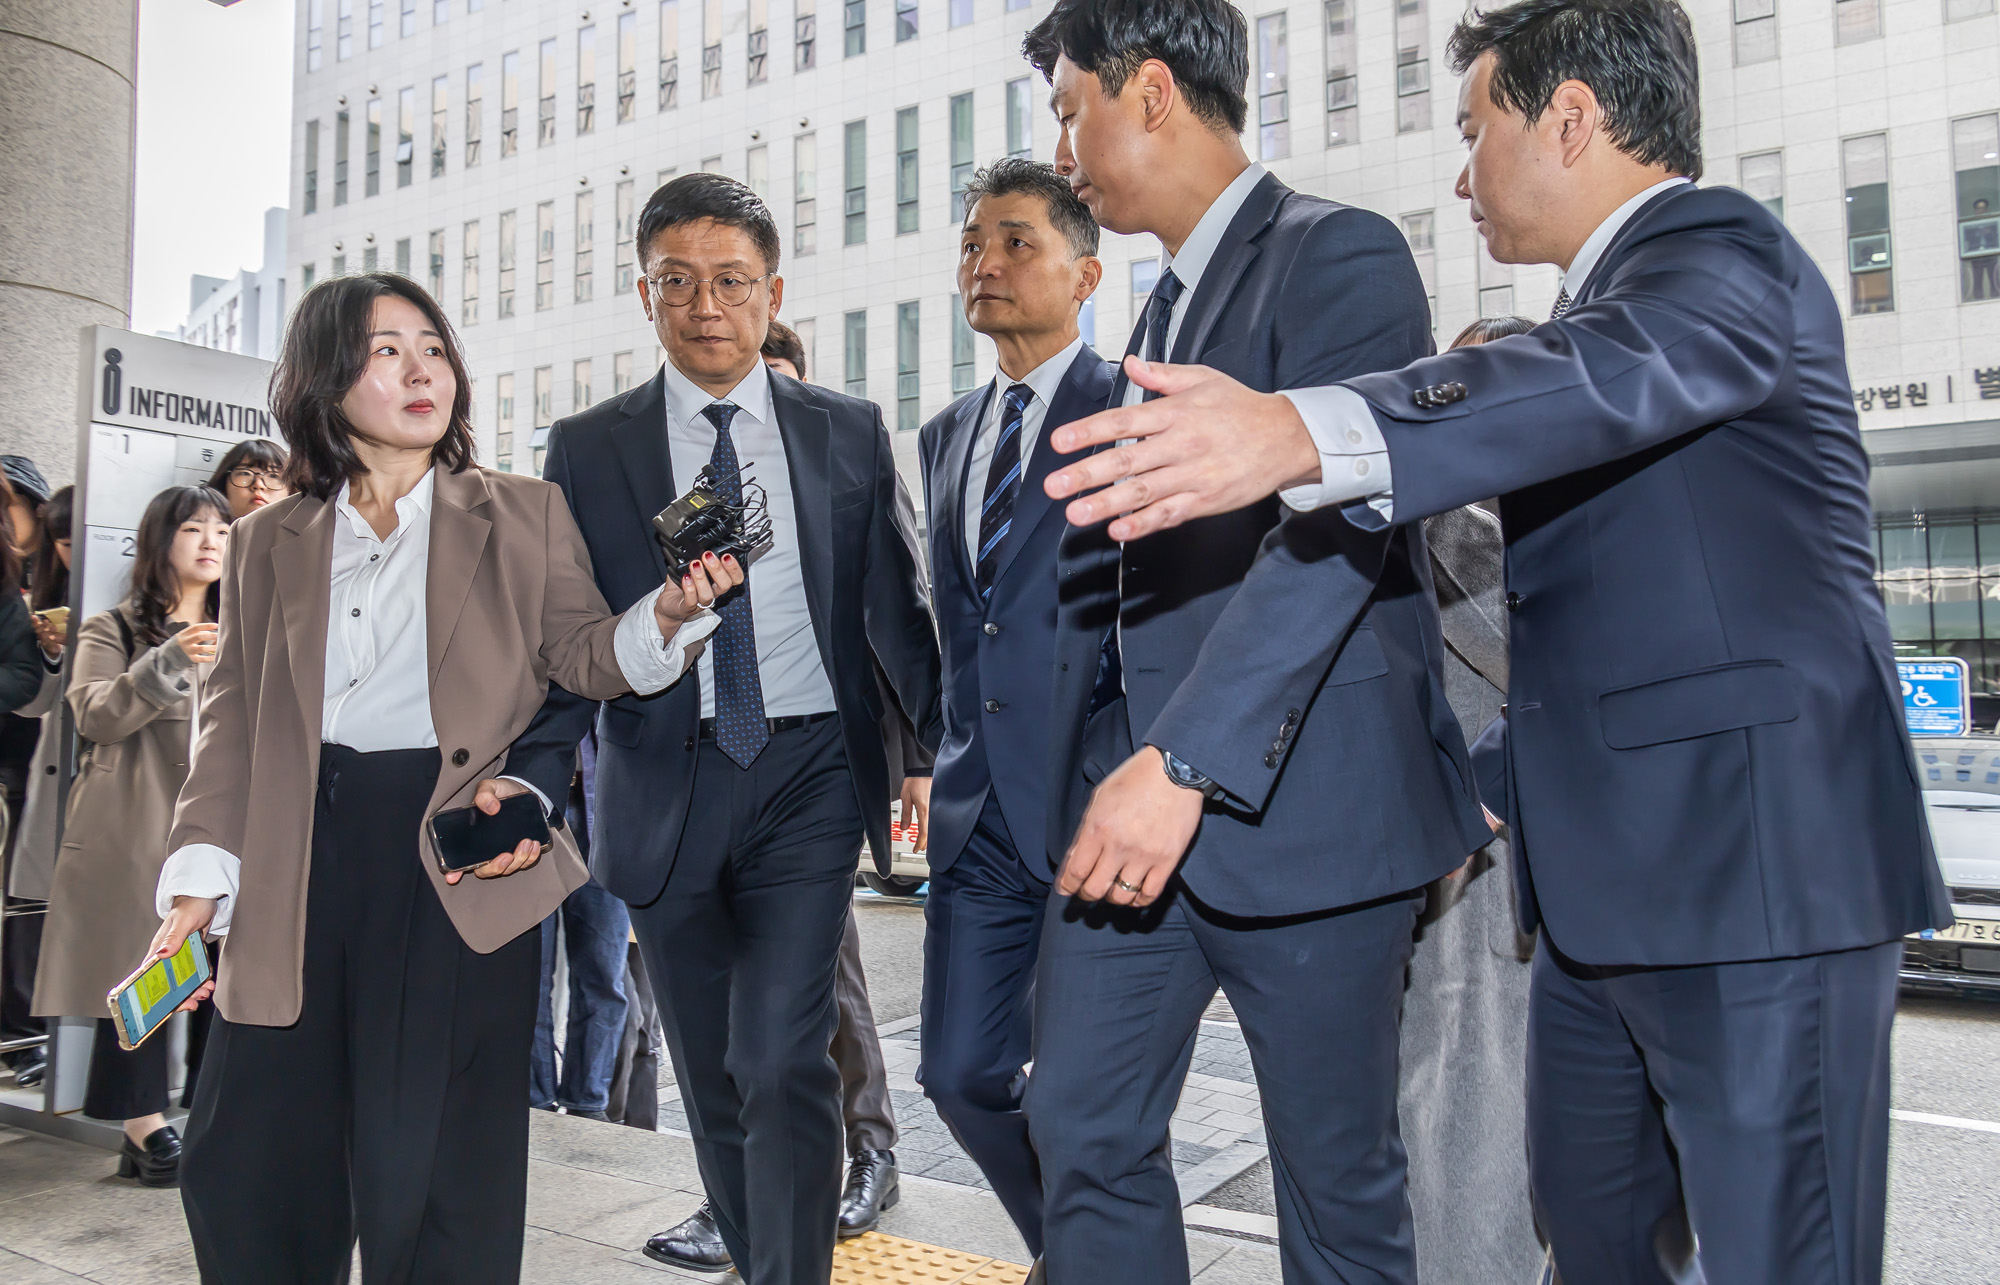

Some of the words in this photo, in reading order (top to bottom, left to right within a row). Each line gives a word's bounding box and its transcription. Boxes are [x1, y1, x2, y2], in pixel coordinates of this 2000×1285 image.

[1853, 382, 1928, 411] 방법원
[130, 386, 270, 437] INFORMATION
[122, 434, 130, 454] 1
[121, 536, 138, 557] 2
